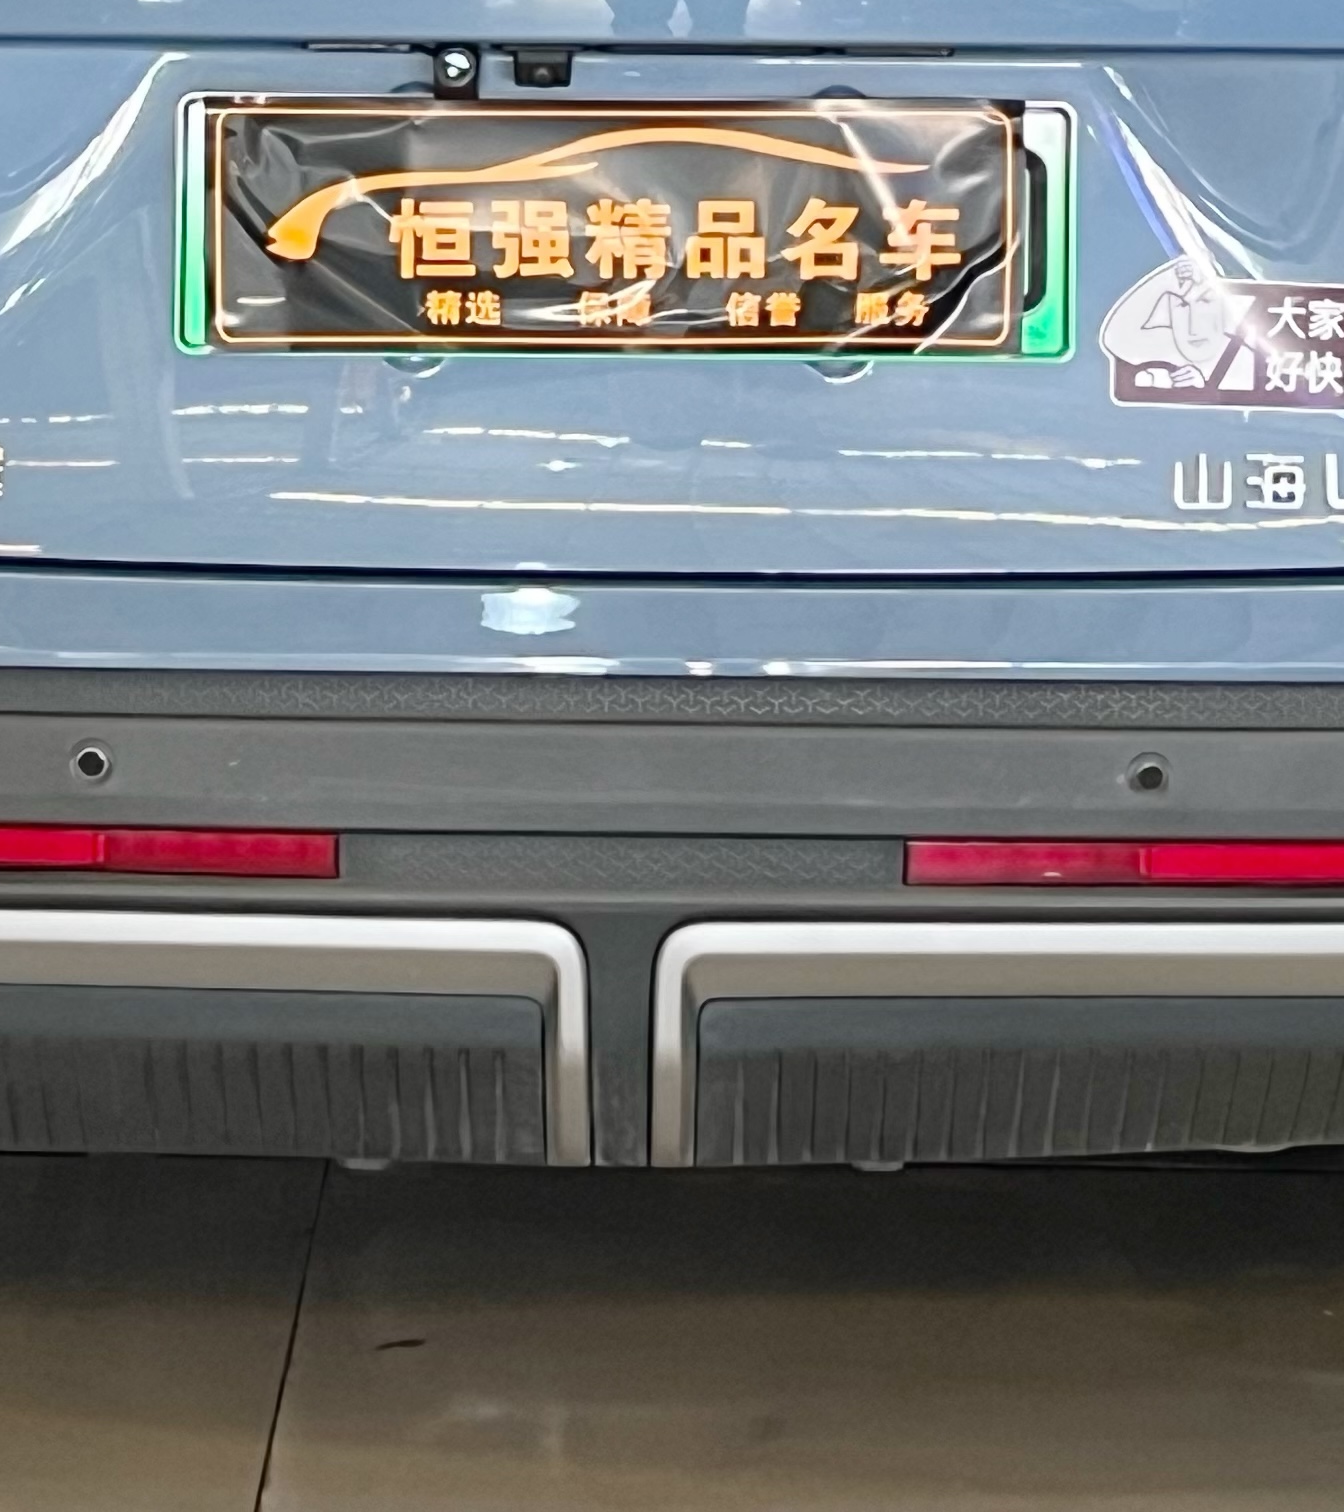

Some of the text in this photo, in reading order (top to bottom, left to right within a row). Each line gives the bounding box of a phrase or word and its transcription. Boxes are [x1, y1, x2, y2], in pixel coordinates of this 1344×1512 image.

[389, 197, 962, 281] 恒强精品名车
[425, 291, 502, 327] 精选
[725, 291, 802, 327] 信誉
[854, 291, 931, 327] 服务
